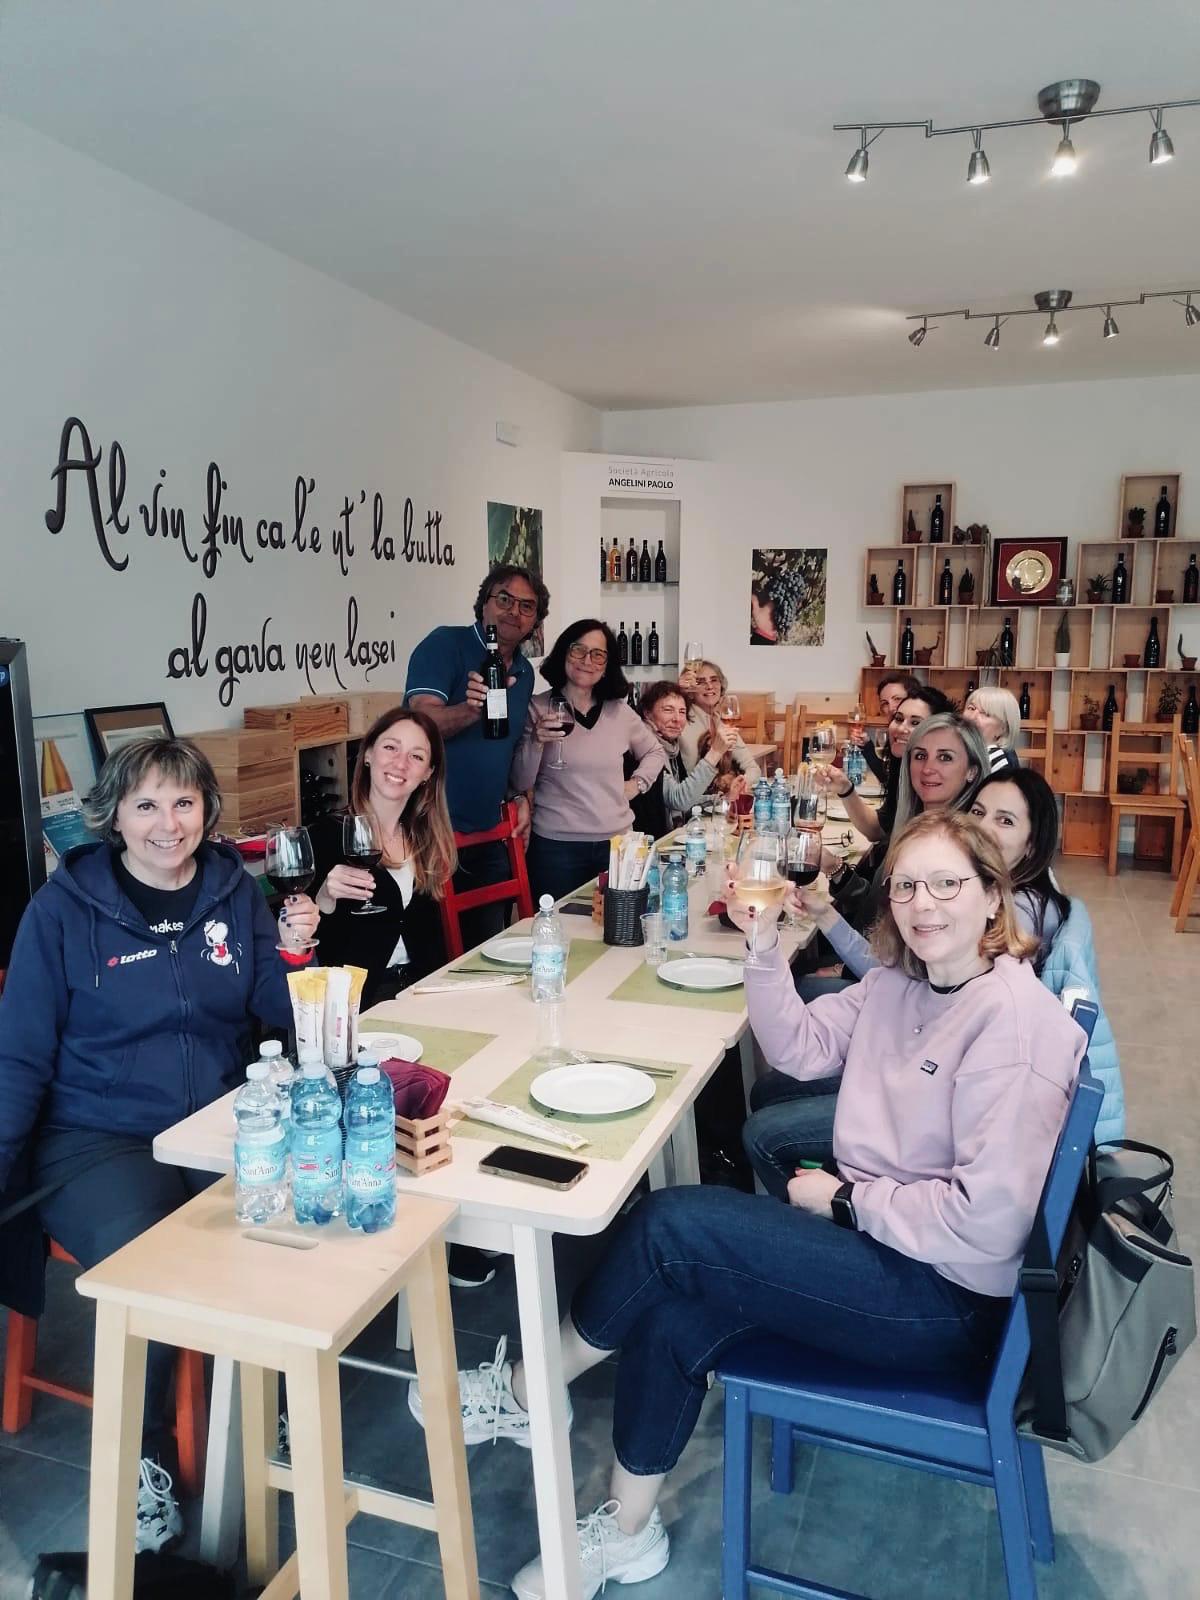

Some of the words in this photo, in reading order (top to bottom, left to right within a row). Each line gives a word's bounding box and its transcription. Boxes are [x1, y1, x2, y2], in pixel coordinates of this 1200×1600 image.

[44, 416, 130, 571] Al
[139, 468, 199, 563] vin
[201, 461, 254, 579] fin
[256, 519, 286, 549] ca
[401, 497, 456, 566] butta
[608, 478, 646, 488] ANGELINI
[647, 480, 674, 489] PAOLO
[166, 592, 209, 679] al
[214, 617, 286, 708] gava
[295, 641, 348, 696] nen
[343, 595, 396, 682] lasei
